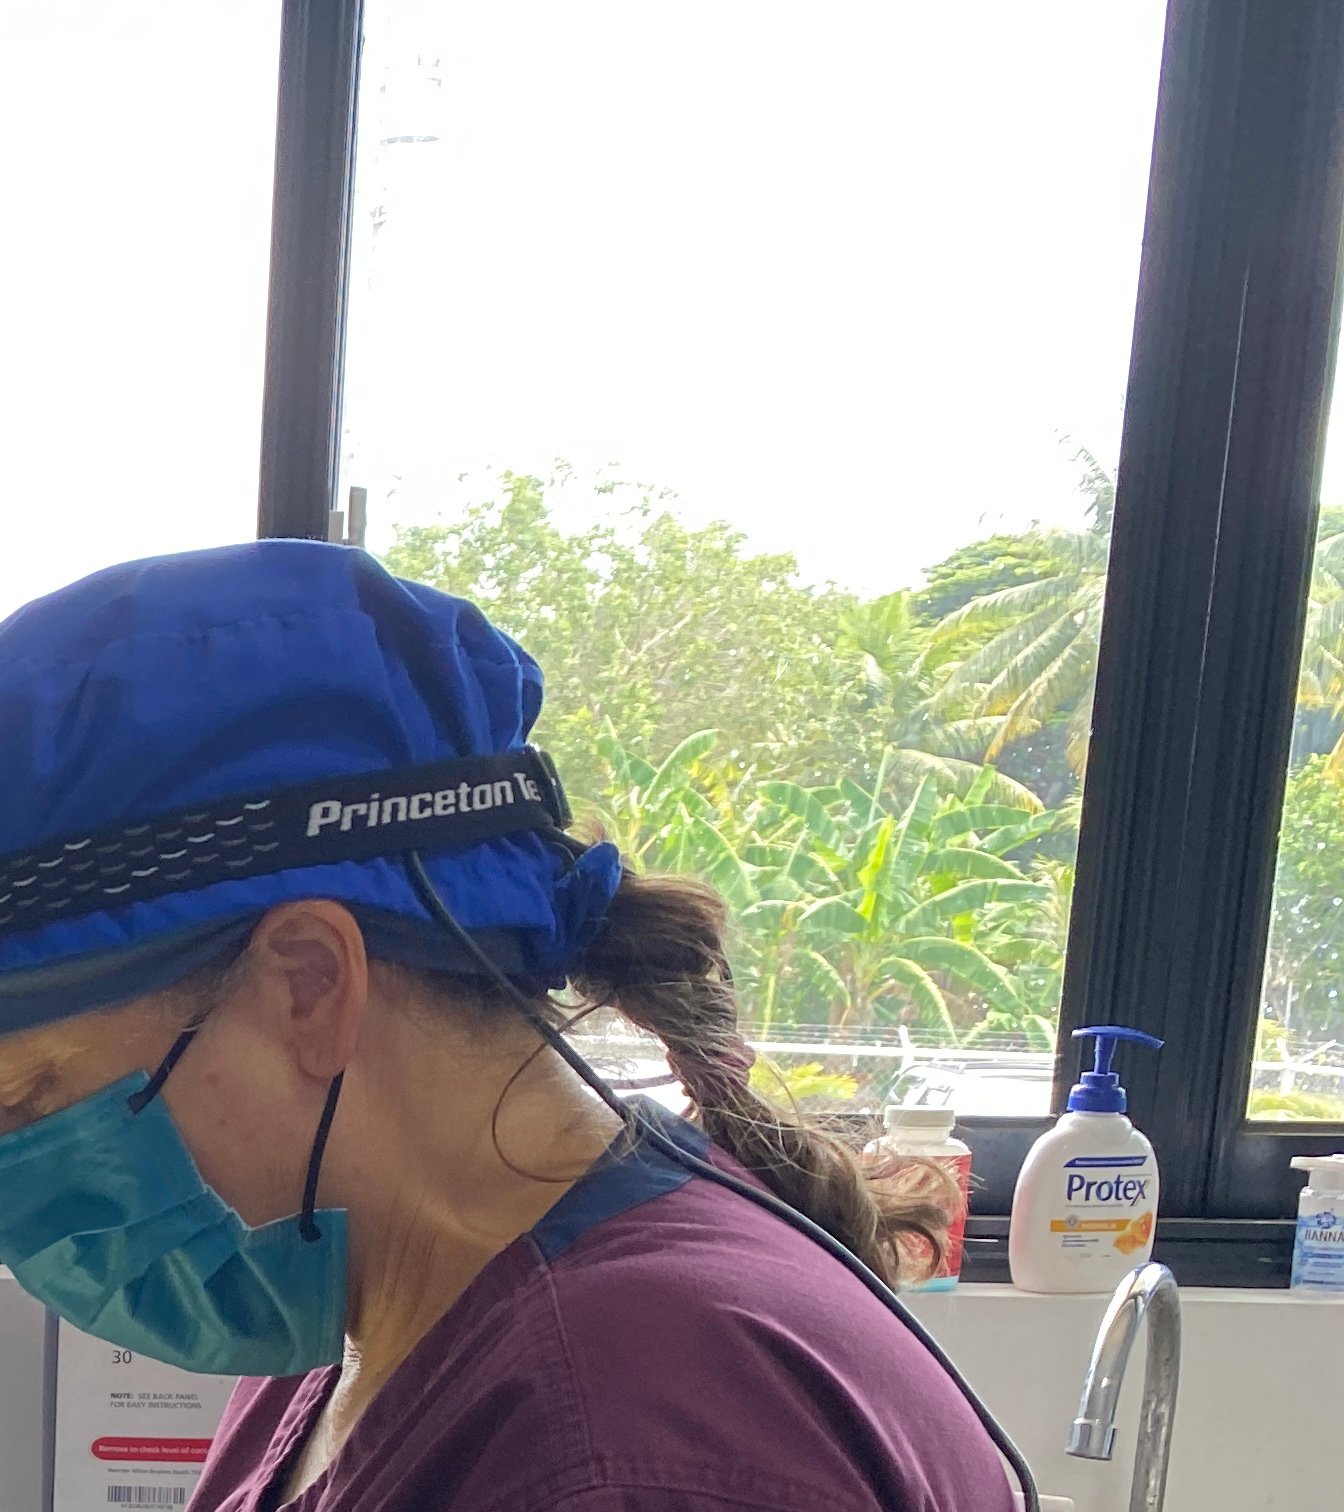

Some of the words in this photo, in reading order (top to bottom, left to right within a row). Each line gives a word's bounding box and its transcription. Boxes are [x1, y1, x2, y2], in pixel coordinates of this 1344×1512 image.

[306, 780, 515, 837] Princeton
[1066, 1173, 1148, 1207] Protex
[112, 1350, 132, 1364] 30
[98, 1445, 128, 1453] Remove
